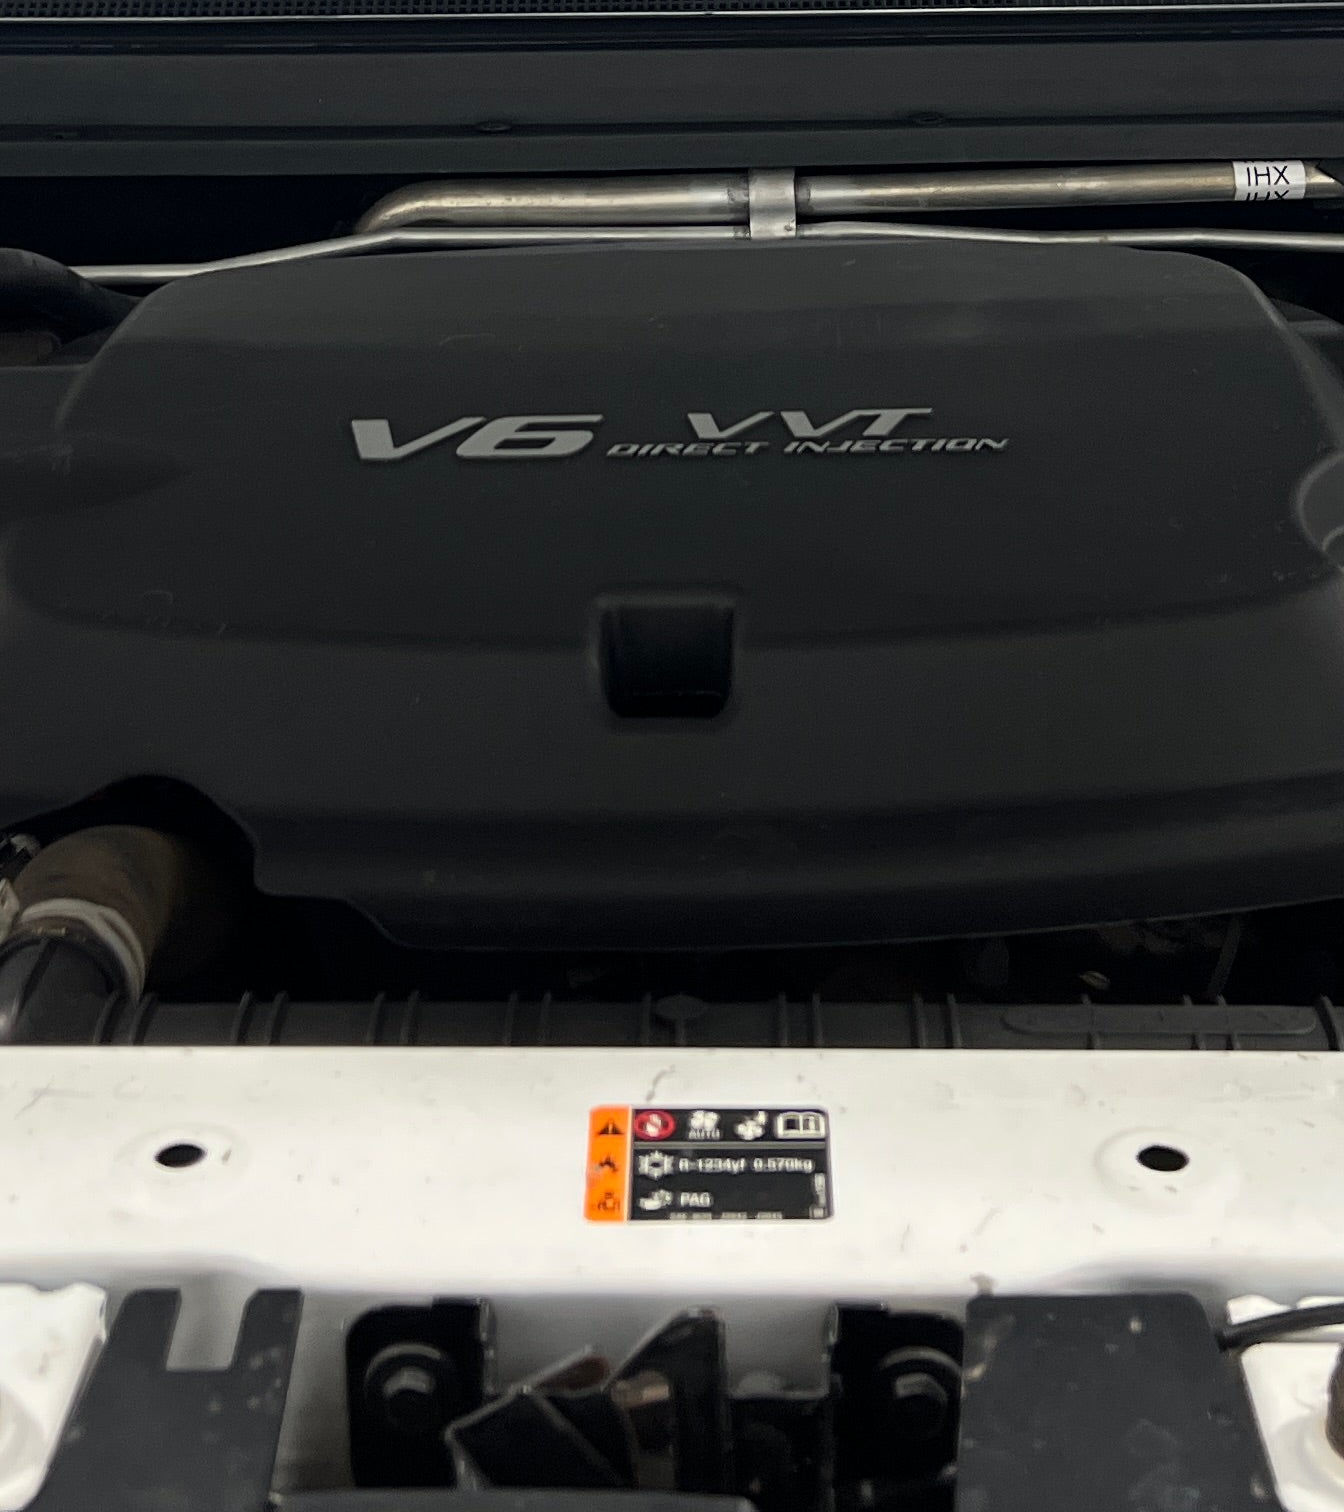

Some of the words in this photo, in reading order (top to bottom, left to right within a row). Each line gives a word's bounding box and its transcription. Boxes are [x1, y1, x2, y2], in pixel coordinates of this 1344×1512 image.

[1246, 165, 1291, 186] IHX
[687, 407, 933, 440] VVT
[351, 414, 603, 459] V6
[606, 441, 770, 458] DIRECT
[783, 438, 1009, 454] INJECTION
[680, 1192, 710, 1207] PAG
